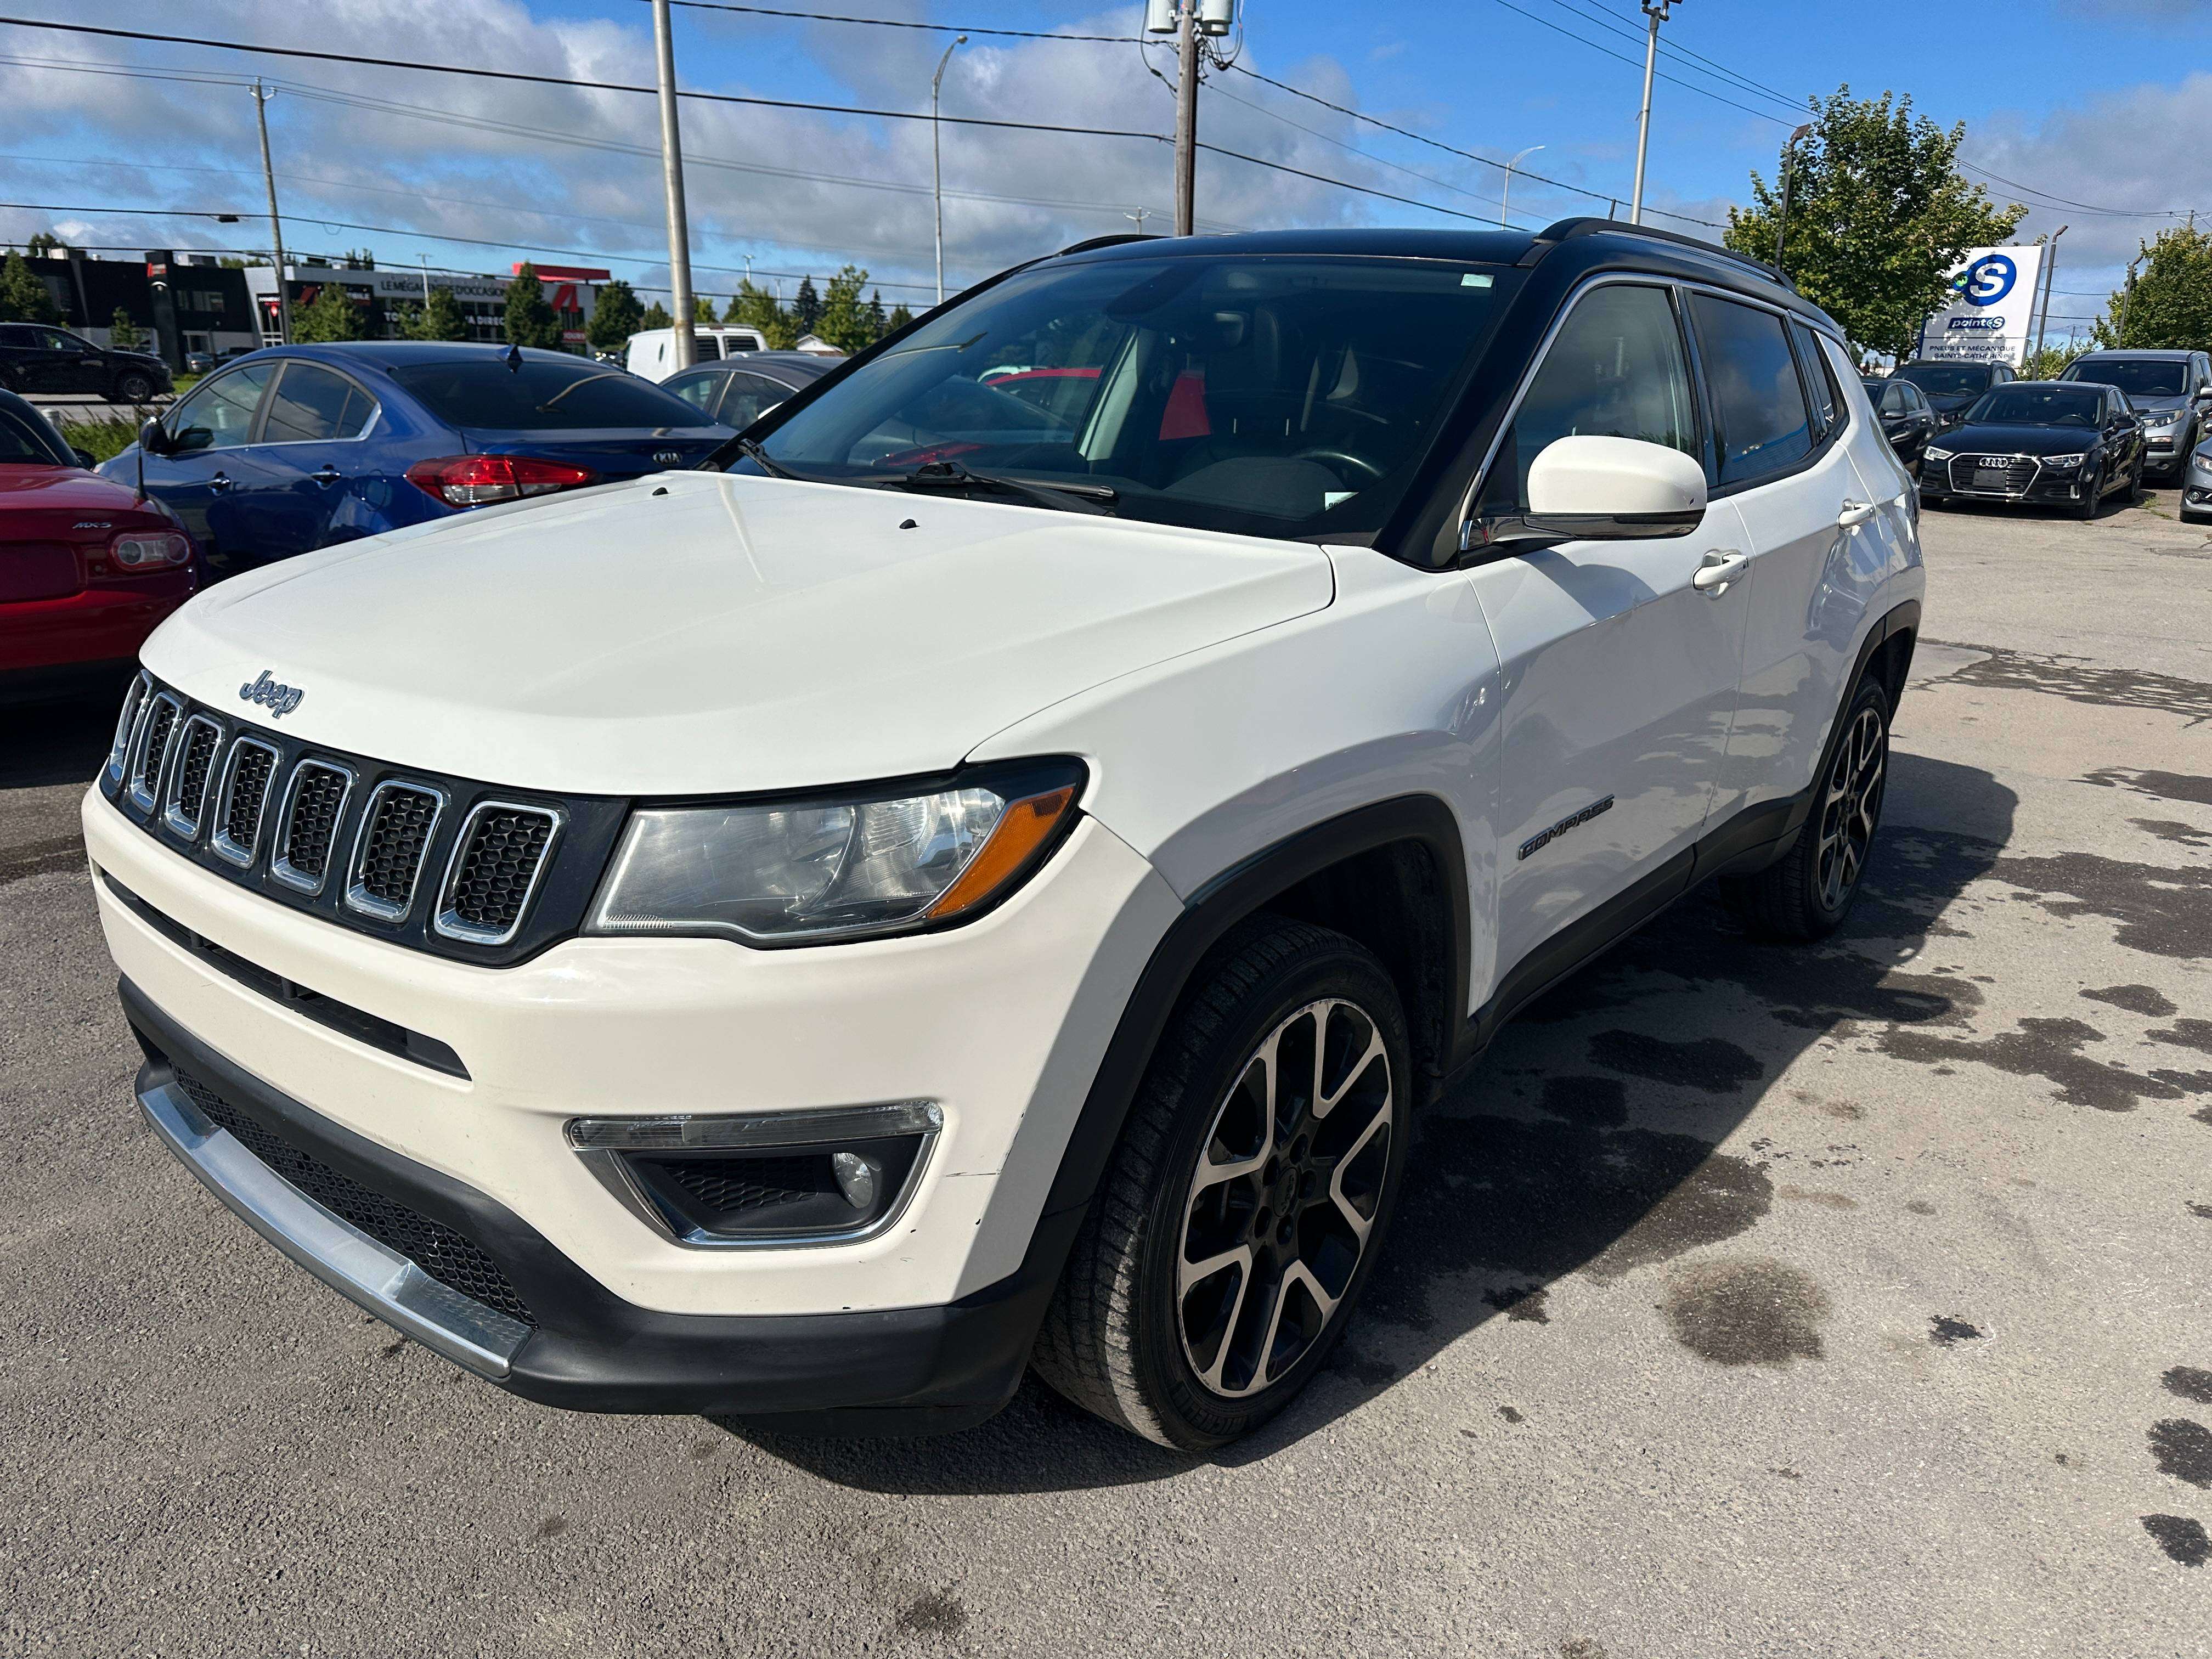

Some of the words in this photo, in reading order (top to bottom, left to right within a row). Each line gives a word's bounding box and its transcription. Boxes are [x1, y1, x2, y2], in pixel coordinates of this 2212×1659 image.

[658, 452, 680, 463] KIA
[239, 669, 305, 720] Jeep
[1517, 793, 1615, 861] COMPASS
